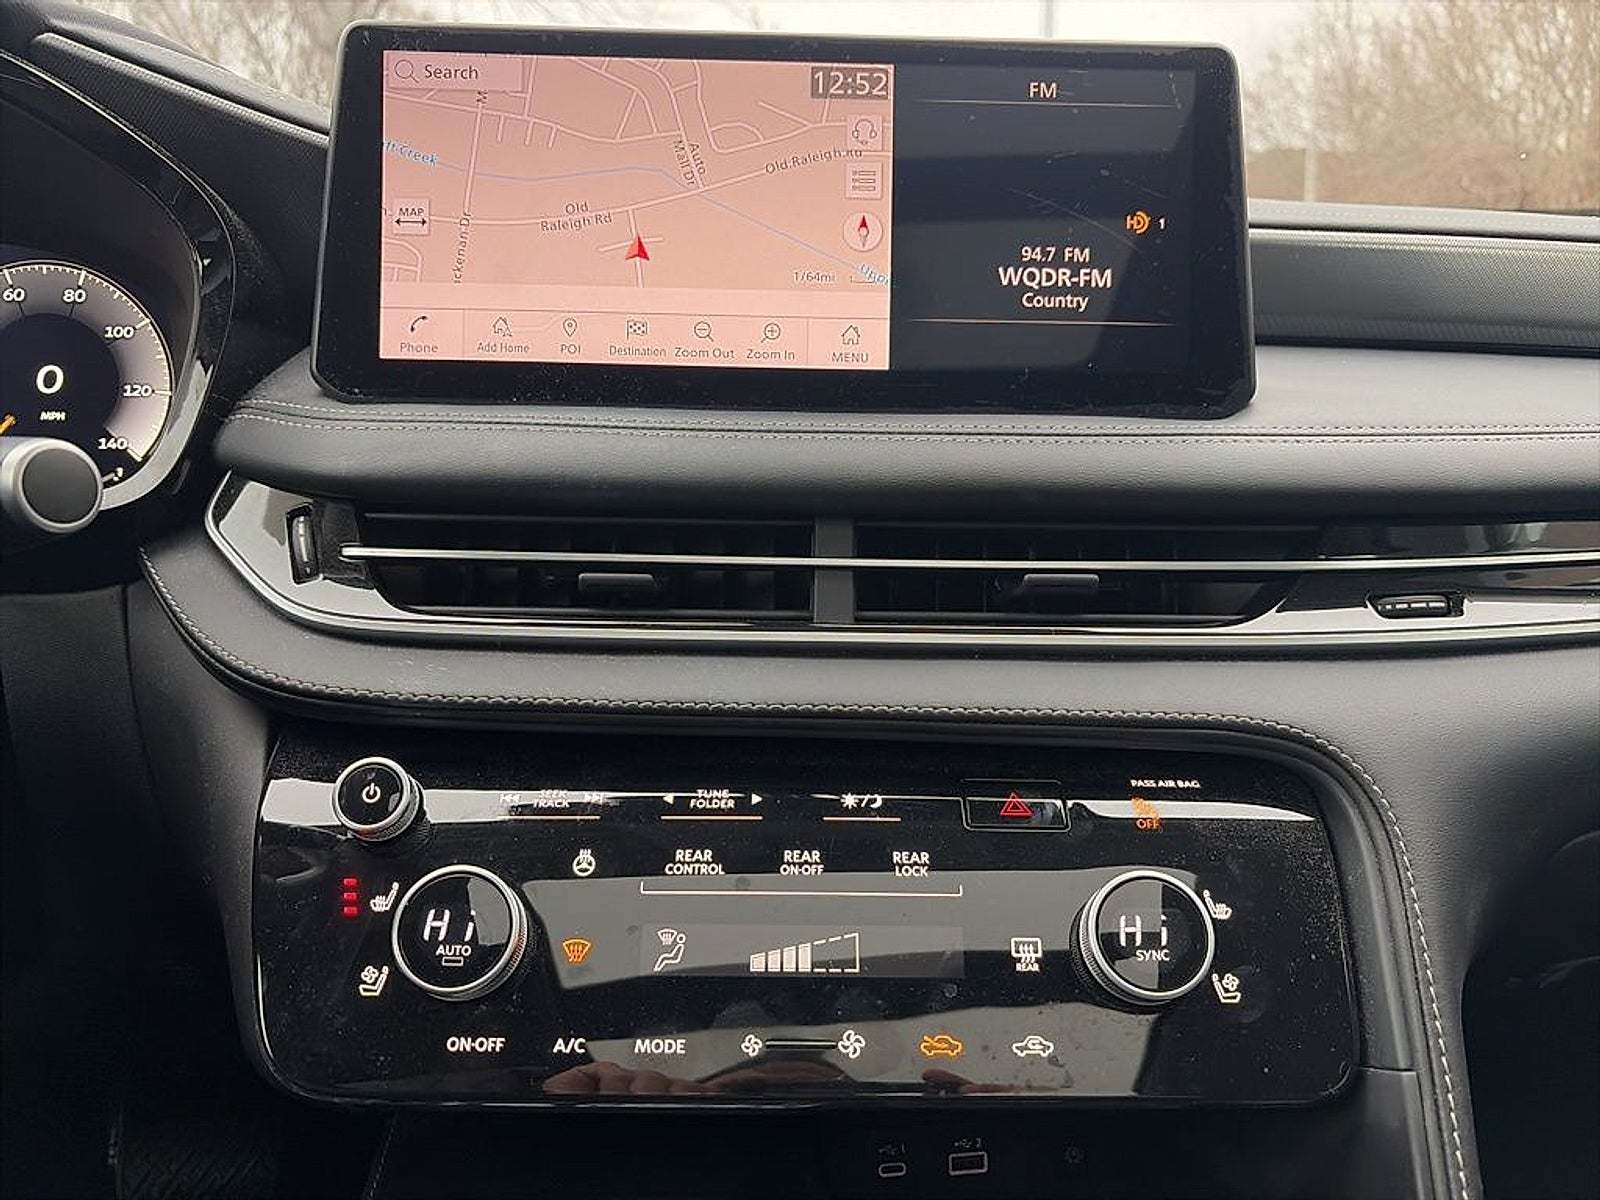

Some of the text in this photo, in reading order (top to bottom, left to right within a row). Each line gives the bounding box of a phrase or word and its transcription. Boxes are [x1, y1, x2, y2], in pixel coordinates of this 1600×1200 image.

[424, 64, 479, 80] Search
[814, 71, 887, 95] 12:52
[1029, 82, 1057, 98] FM
[673, 140, 695, 185] Mall Dr
[690, 143, 706, 175] Auto
[765, 160, 789, 174] Old
[791, 147, 842, 168] Raleigh
[399, 207, 425, 217] MAP
[565, 202, 589, 214] Old
[460, 212, 471, 226] Dr
[540, 213, 613, 232] Raleigh Rd
[1159, 217, 1165, 229] 1
[1021, 246, 1090, 263] 94.7 FM
[998, 267, 1112, 289] WQDR-FM
[3, 288, 25, 301] 60
[63, 290, 86, 302] 80
[1021, 292, 1089, 312] Country
[105, 326, 134, 338] 100
[400, 343, 439, 353] Phone
[477, 343, 530, 353] Add Home
[560, 344, 581, 355] POI
[609, 345, 667, 357] Destination
[674, 347, 735, 359] Zoom Out
[746, 349, 795, 361] Zoom In
[831, 352, 869, 363] MENU
[36, 364, 64, 394] 0
[123, 384, 152, 397] 120
[40, 411, 66, 421] MPH
[98, 438, 128, 450] 140
[1130, 779, 1201, 789] PASS AIR BAG
[696, 789, 730, 799] TUNE
[533, 799, 570, 808] TRACK
[690, 799, 735, 809] FOLDER
[1136, 818, 1162, 830] OFF
[675, 849, 713, 862] REAR
[783, 850, 821, 862] REAR
[892, 851, 930, 864] REAR
[665, 864, 725, 875] CONTROL
[895, 865, 928, 877] LOCK
[436, 945, 472, 957] AUTO
[1135, 950, 1170, 961] SYNC
[1015, 963, 1040, 972] REAR
[553, 1036, 586, 1054] A/C
[634, 1038, 687, 1054] MODE
